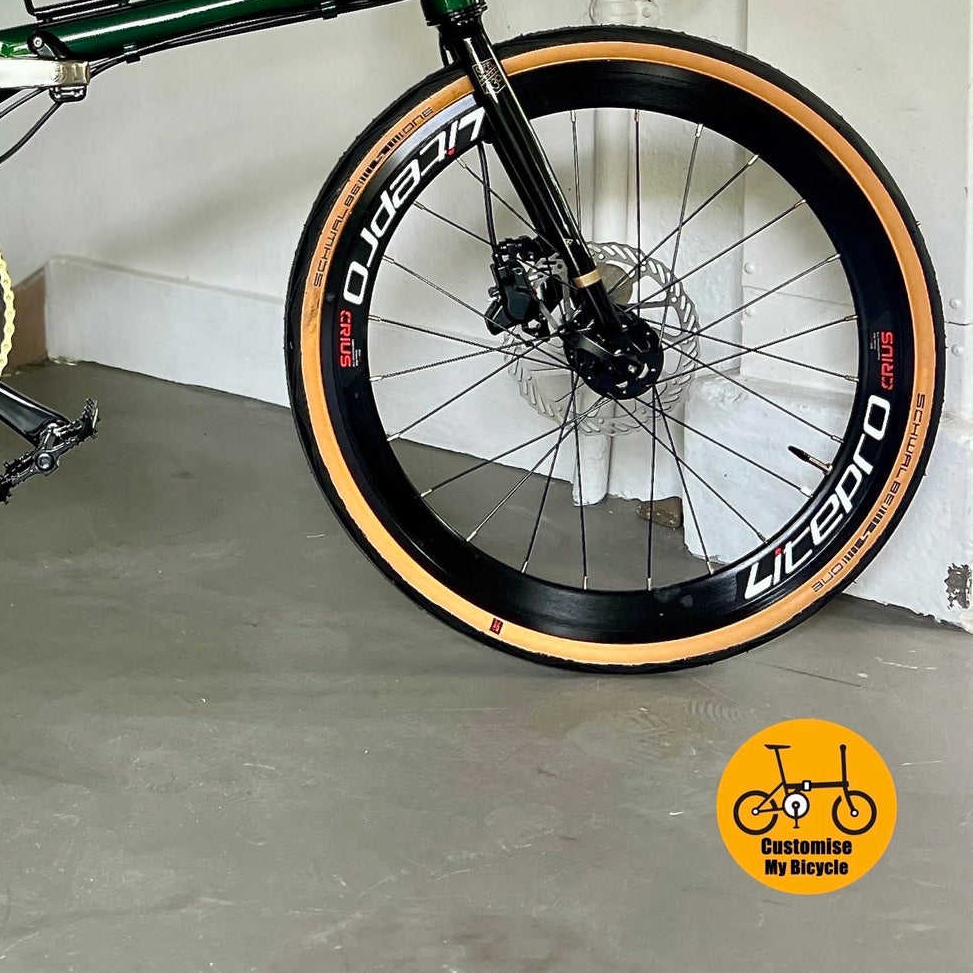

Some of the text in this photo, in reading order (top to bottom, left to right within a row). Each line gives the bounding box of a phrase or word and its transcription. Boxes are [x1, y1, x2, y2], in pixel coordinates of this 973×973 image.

[313, 106, 434, 287] SCHWALBE ONE
[338, 308, 353, 368] CRIUS
[880, 330, 895, 391] CRIUS
[810, 392, 926, 594] SCHWALBE ONE
